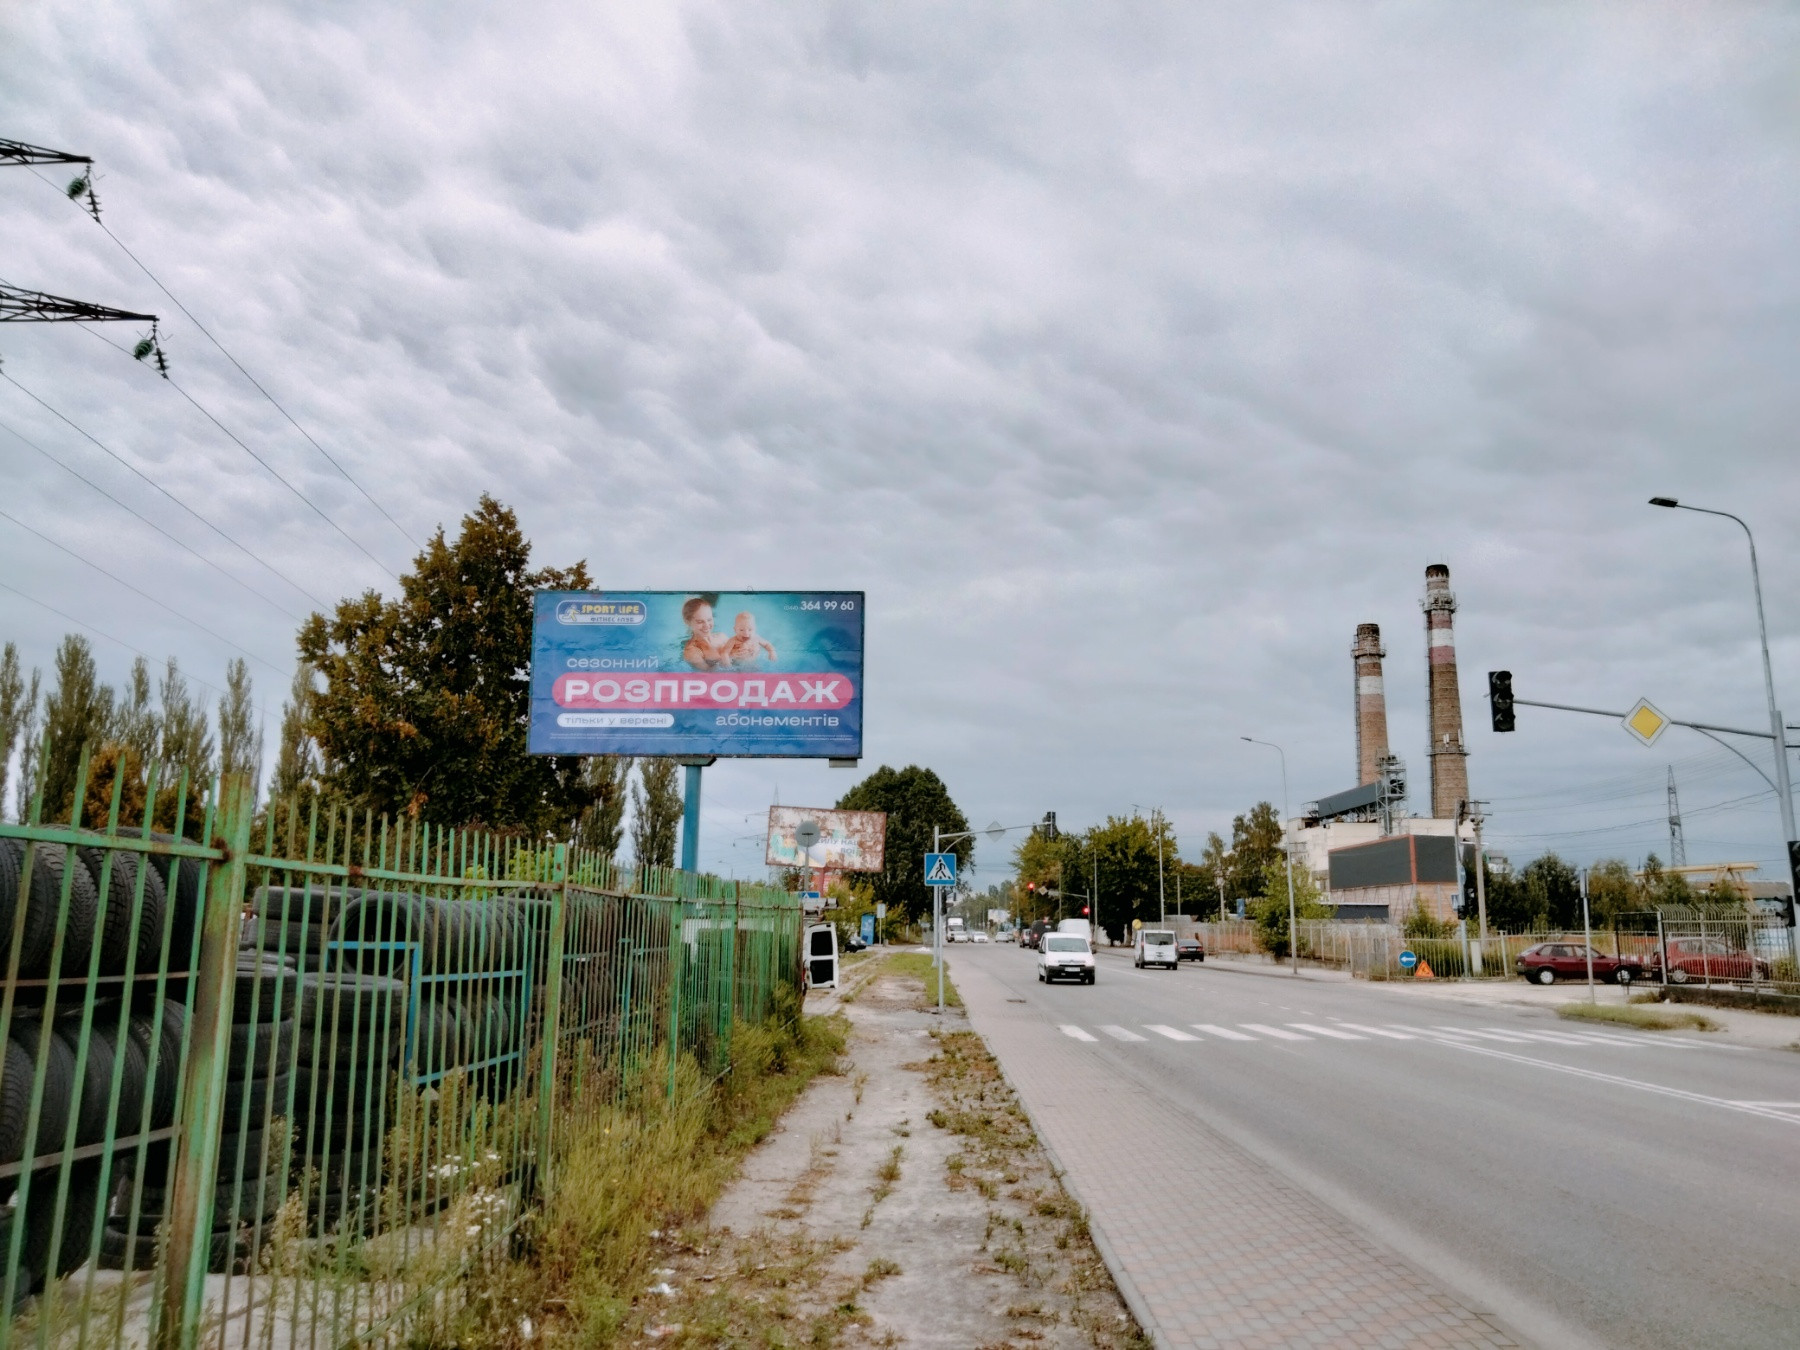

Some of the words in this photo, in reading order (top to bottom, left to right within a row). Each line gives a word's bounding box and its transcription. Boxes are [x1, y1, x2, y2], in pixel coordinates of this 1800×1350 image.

[581, 604, 615, 613] SPORT
[800, 601, 820, 610] 364
[824, 601, 838, 610] 99
[840, 601, 854, 610] 60
[567, 656, 659, 668] сезонний
[565, 679, 840, 706] РОЗПРОДАЖ
[565, 716, 603, 725] тільки
[620, 716, 667, 725] вересні
[716, 713, 839, 727] абонементів
